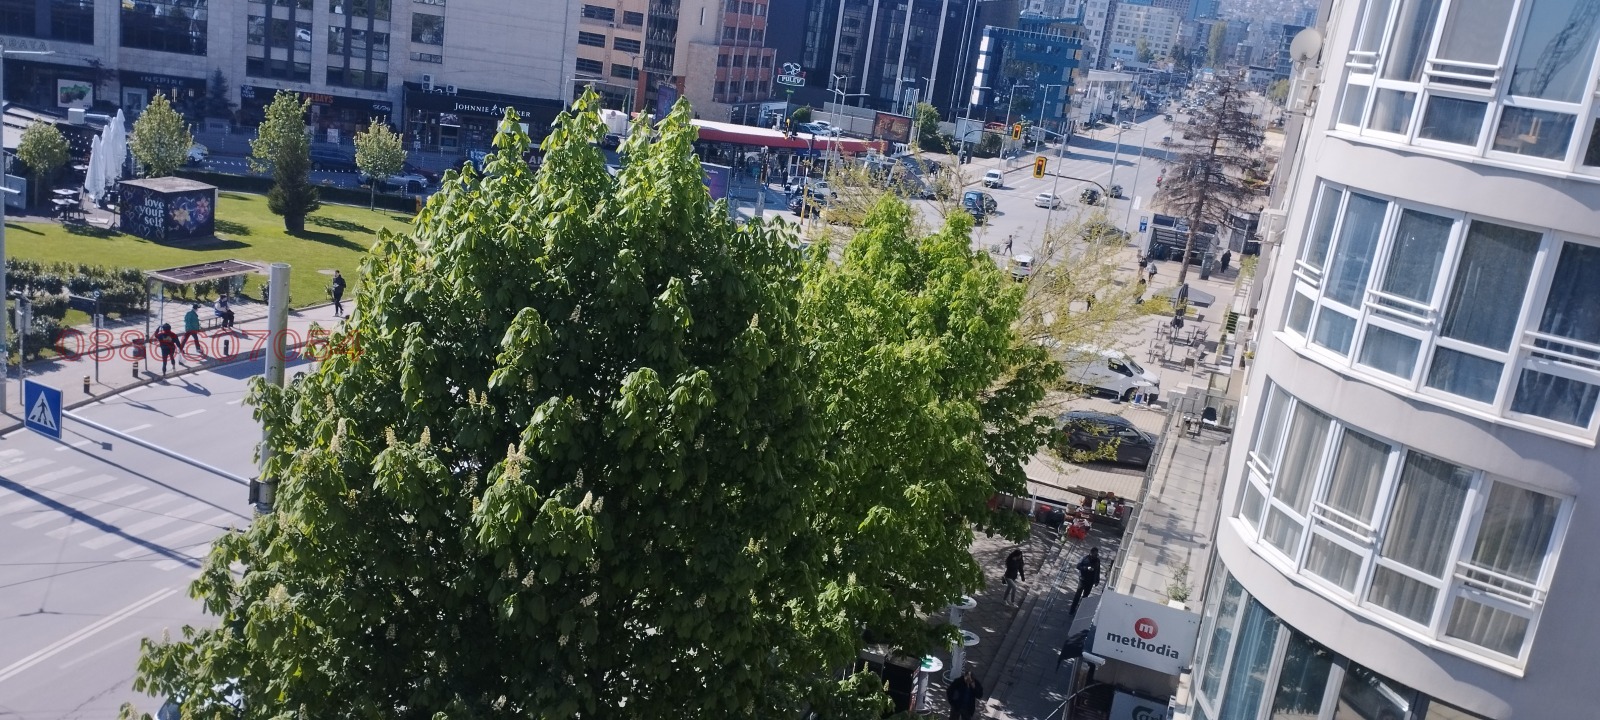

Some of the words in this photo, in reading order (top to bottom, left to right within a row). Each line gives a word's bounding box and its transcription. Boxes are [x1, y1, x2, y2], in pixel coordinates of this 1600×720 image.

[499, 107, 531, 118] WKER
[144, 197, 165, 210] love
[138, 205, 165, 218] your
[144, 216, 164, 228] self
[1106, 632, 1179, 660] methodia
